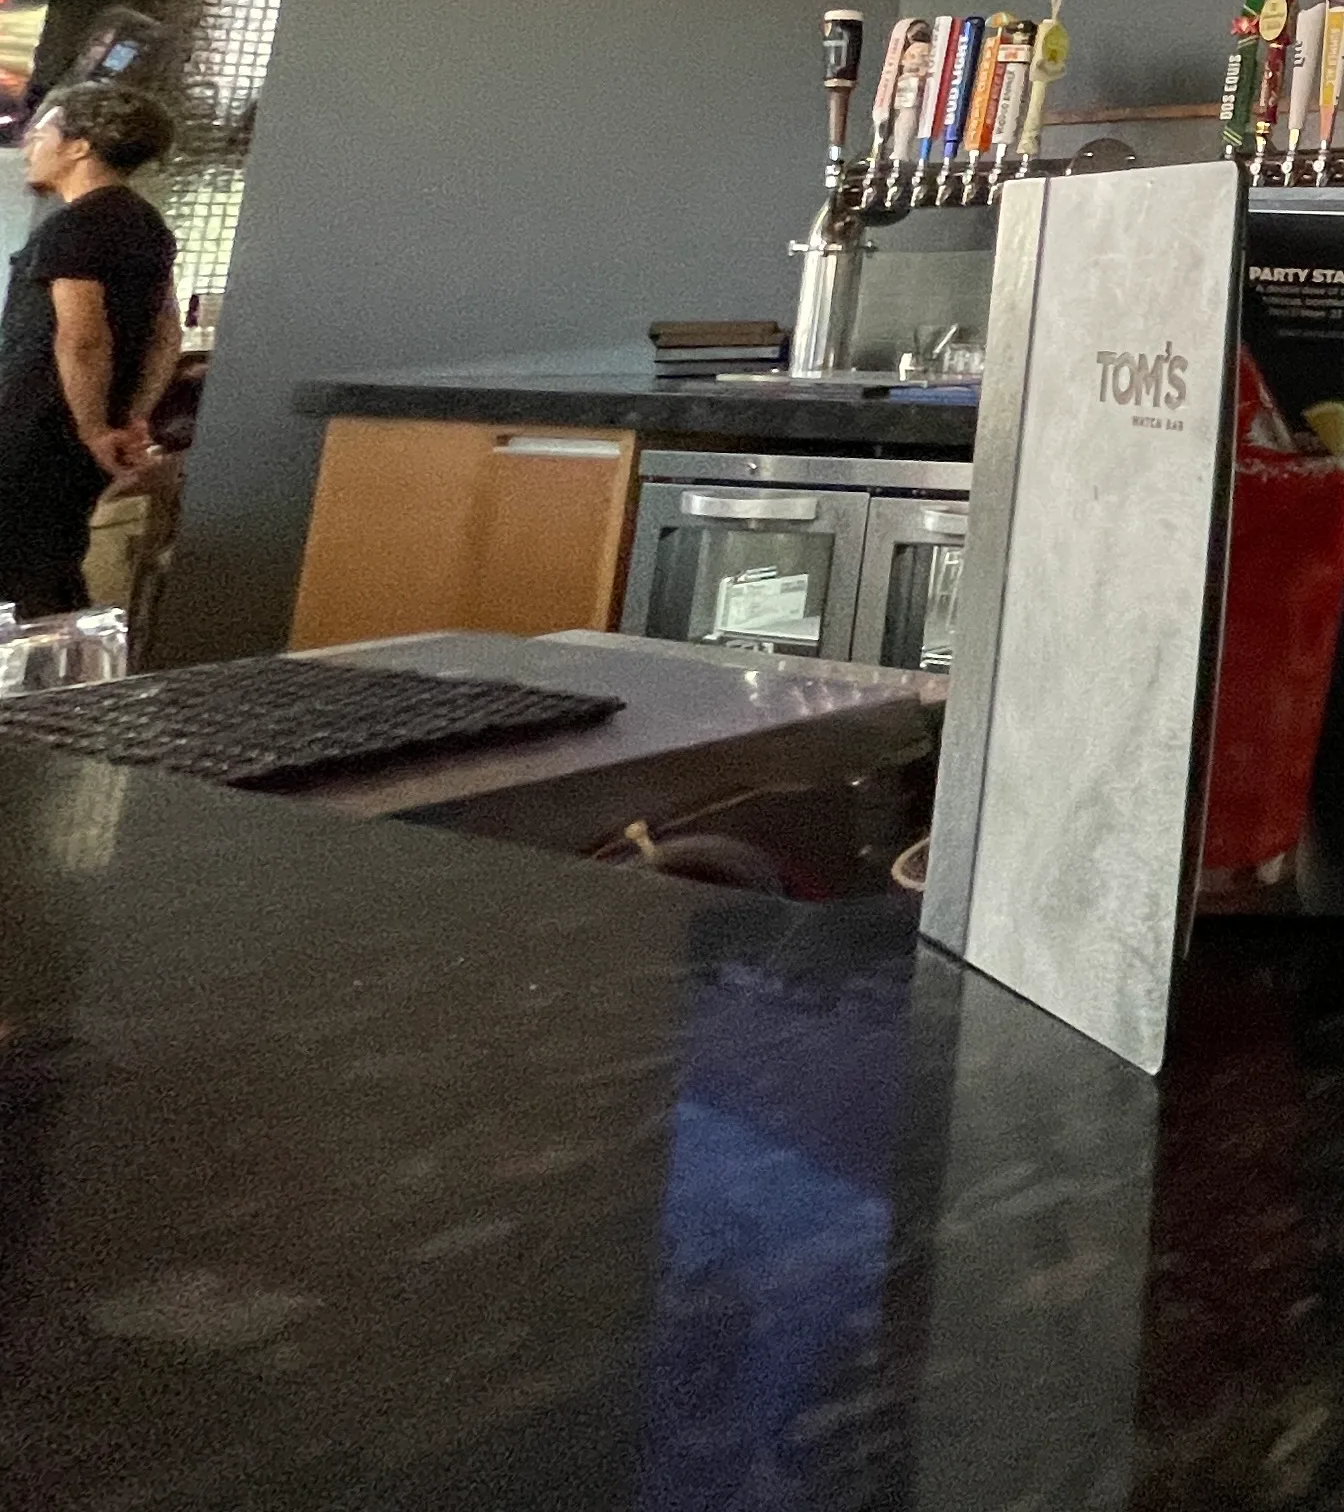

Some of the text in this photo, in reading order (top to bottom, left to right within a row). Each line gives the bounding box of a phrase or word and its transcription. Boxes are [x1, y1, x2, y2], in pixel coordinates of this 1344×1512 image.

[944, 35, 968, 125] BUD LIGHT
[1220, 54, 1242, 120] DOS EQUIS
[1249, 266, 1309, 283] PARTY
[1096, 341, 1188, 410] TOM'S
